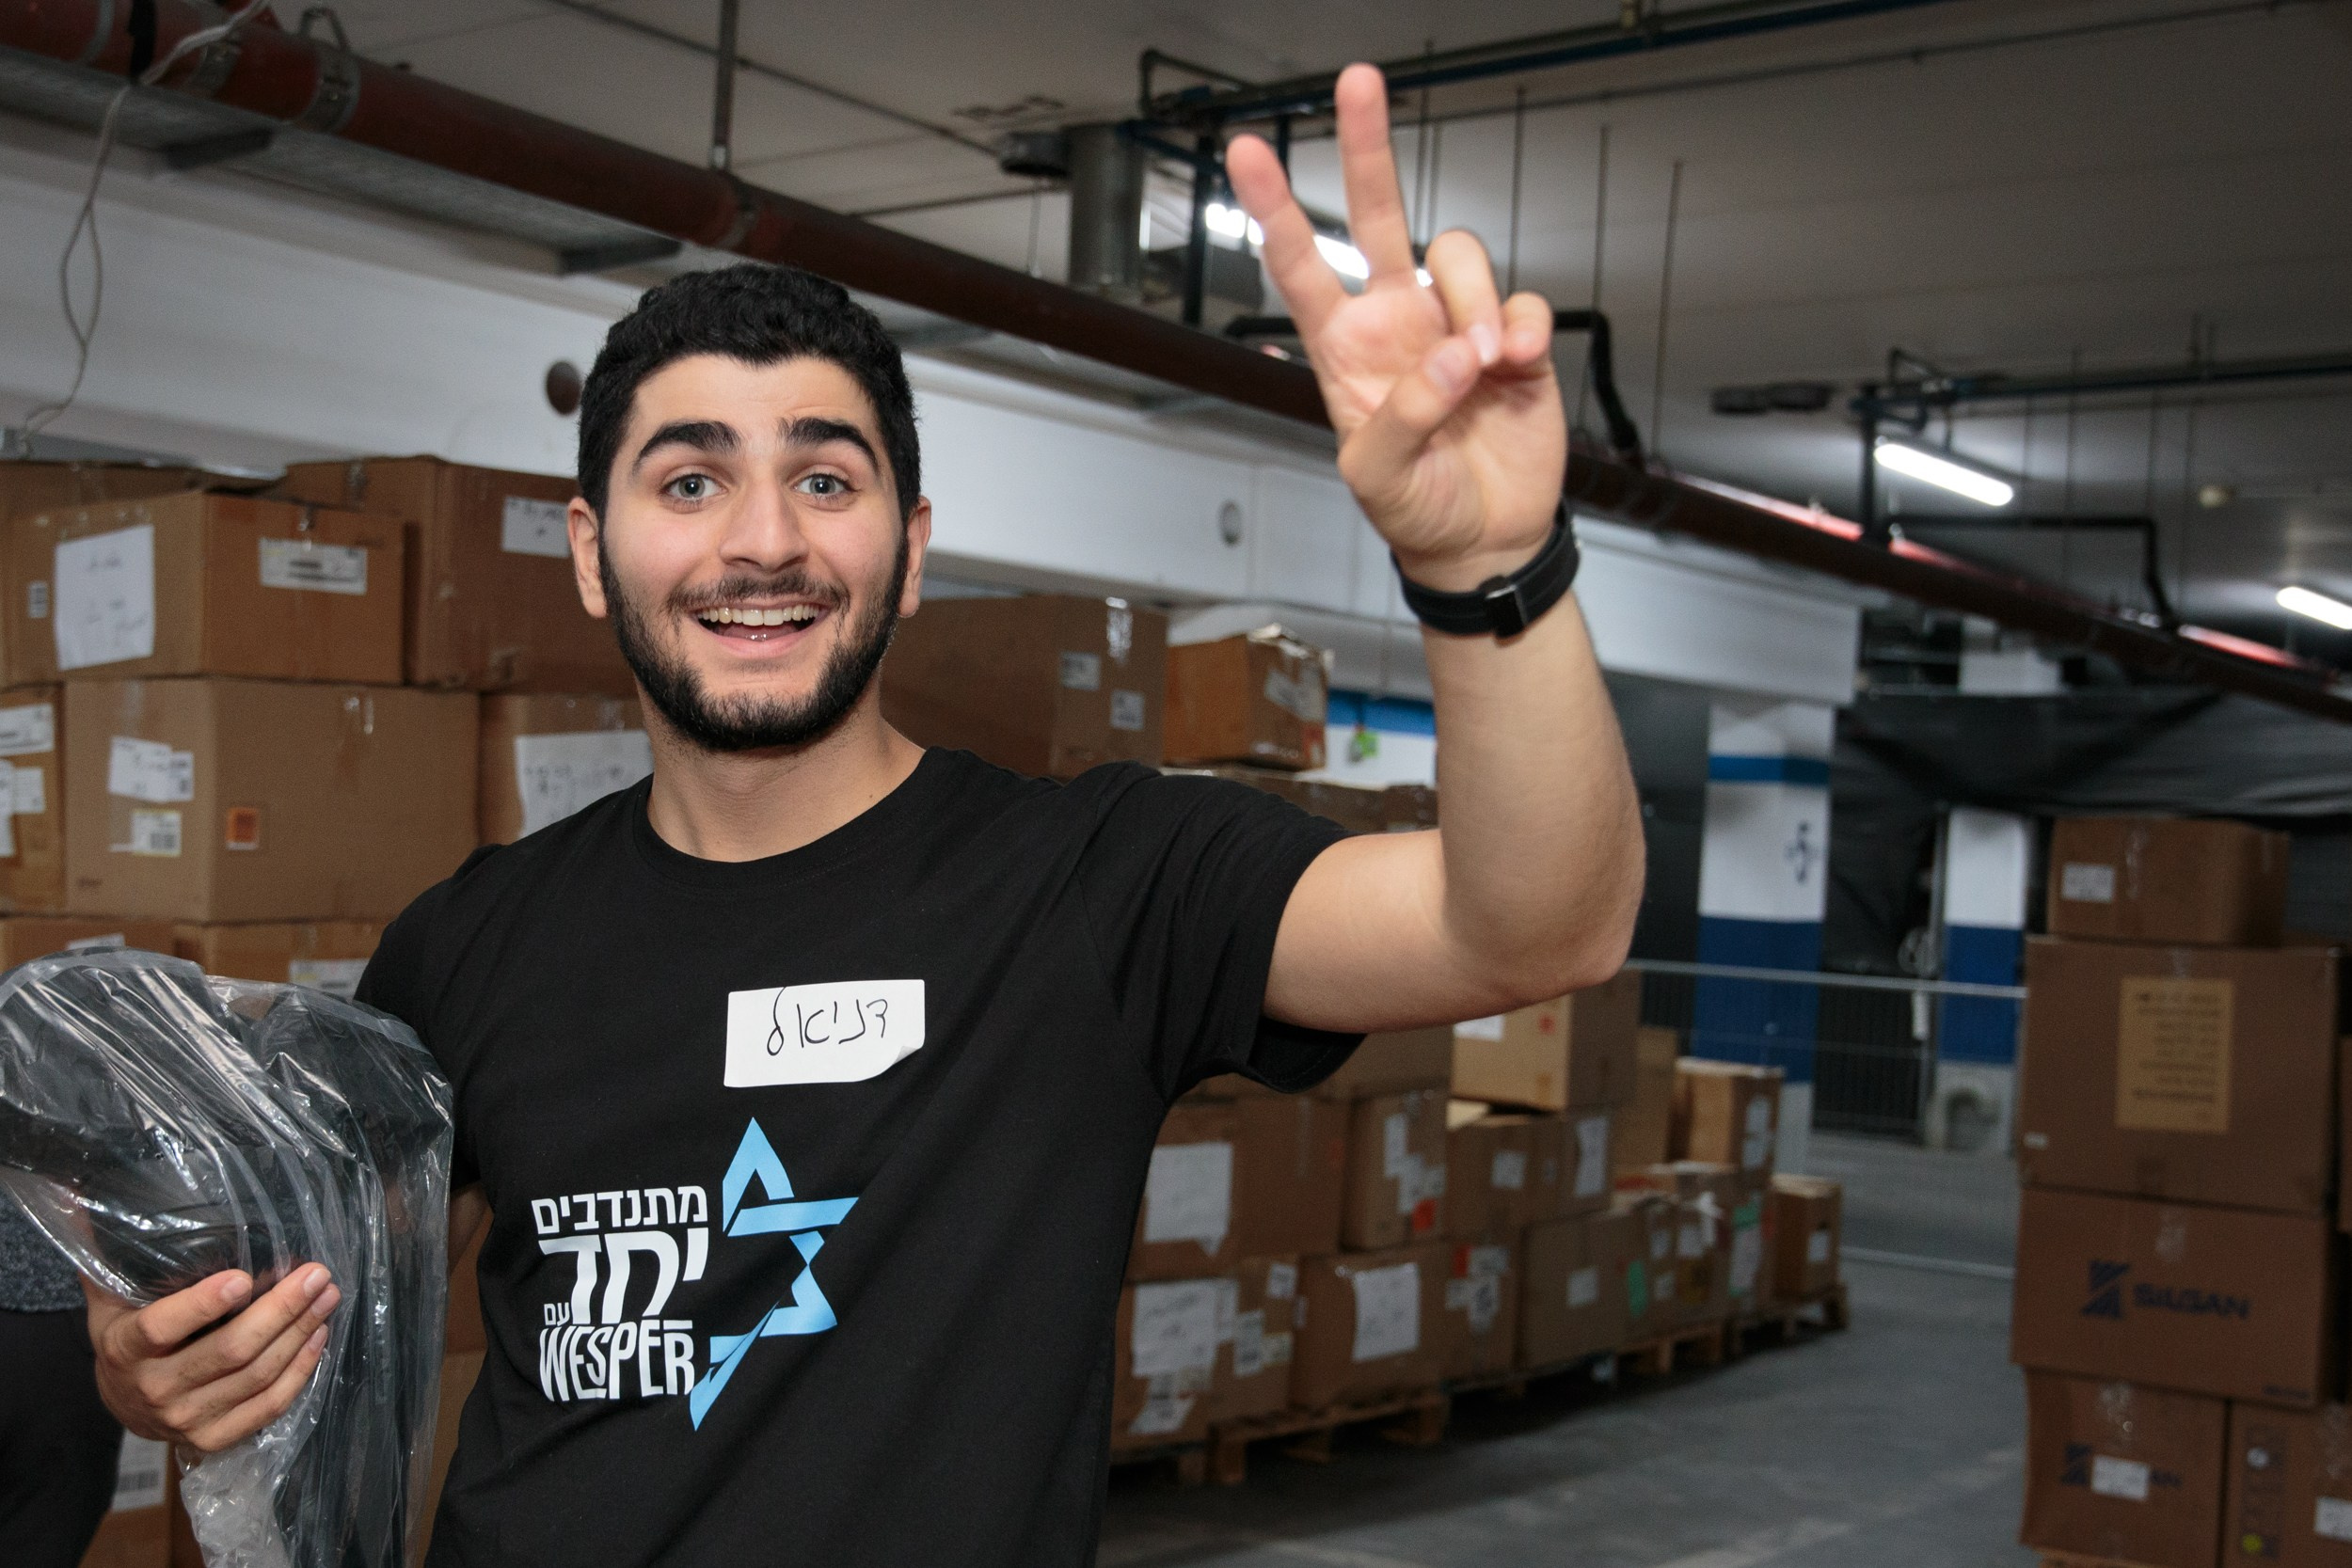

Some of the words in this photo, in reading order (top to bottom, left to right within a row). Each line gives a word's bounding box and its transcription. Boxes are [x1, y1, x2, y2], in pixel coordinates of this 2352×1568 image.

[767, 987, 888, 1056] דניאל
[531, 1185, 708, 1235] מתנדבים
[538, 1227, 709, 1324] יחד
[544, 1302, 570, 1326] עם
[539, 1319, 695, 1402] WESPER
